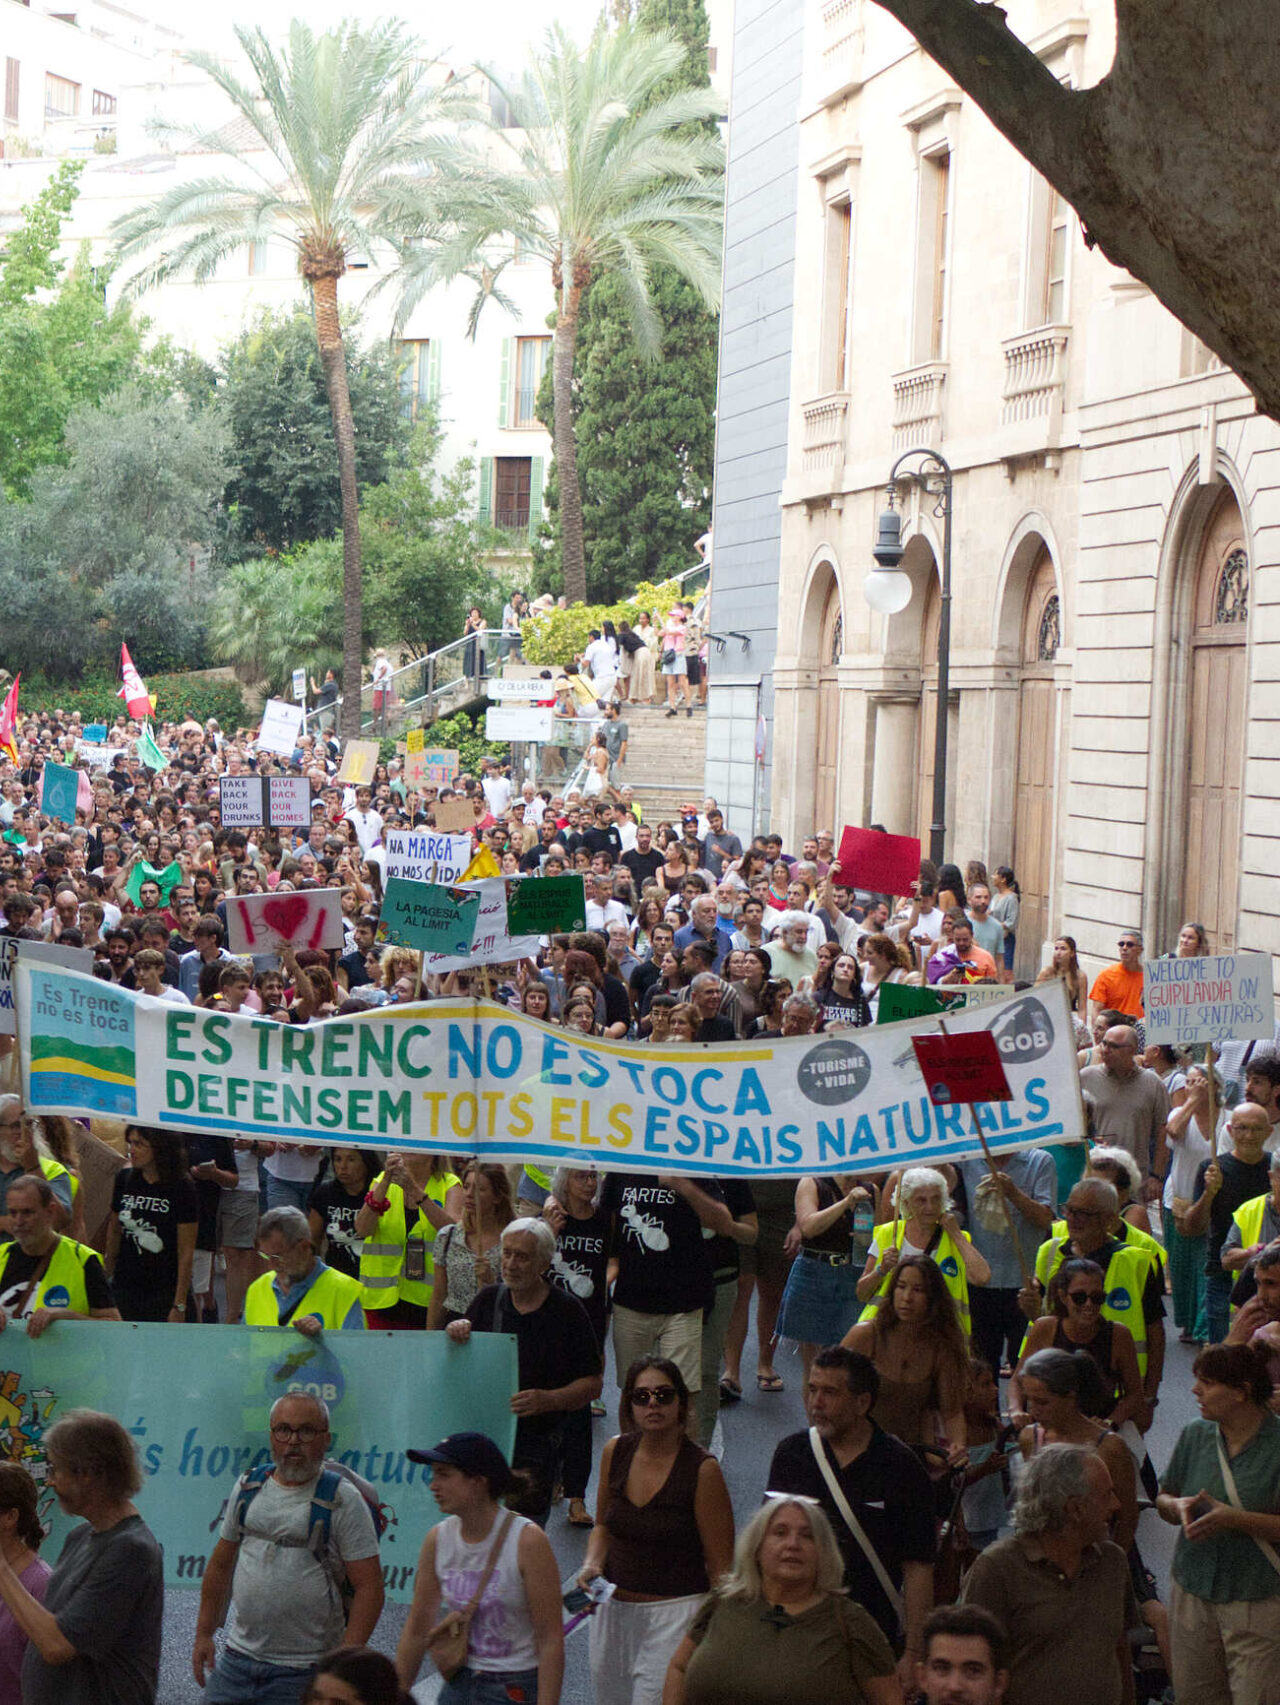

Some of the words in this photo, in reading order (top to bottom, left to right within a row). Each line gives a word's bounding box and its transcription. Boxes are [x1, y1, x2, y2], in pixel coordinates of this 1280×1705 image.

[223, 780, 247, 788] TAKE
[271, 780, 295, 788] GIVE
[223, 791, 248, 799] BACK
[271, 791, 297, 799] BACK
[271, 803, 291, 811] OUR
[223, 813, 260, 821] DRUNKS
[271, 814, 304, 822] HOMES
[389, 839, 404, 855] NA
[408, 837, 452, 861] MARGA
[387, 866, 400, 878] NO
[402, 866, 423, 880] MOS
[395, 901, 410, 914] LA
[404, 915, 419, 927] AL
[1147, 958, 1208, 984] WELCOME
[1214, 956, 1235, 979] TO
[1239, 976, 1259, 1001] ON
[43, 983, 63, 1003] Es
[70, 987, 120, 1014] Trenc
[36, 1000, 57, 1017] no
[63, 1008, 83, 1025] es
[88, 1009, 130, 1033] toca
[891, 1006, 906, 1017] EL
[1150, 1007, 1170, 1028] MAI
[1177, 1007, 1191, 1026] TE
[997, 1030, 1049, 1055] GOB
[1174, 1027, 1200, 1042] TOT
[1209, 1026, 1238, 1040] SOL
[166, 1009, 233, 1066] ES
[250, 1019, 432, 1079] TRENC
[448, 1023, 523, 1080] NO
[540, 1032, 610, 1089] ES
[617, 1059, 772, 1117] TOCA
[824, 1071, 857, 1089] VIDA
[166, 1068, 411, 1136] DEFENSEM
[423, 1090, 535, 1139] TOTS
[550, 1096, 634, 1149] ELS
[644, 1105, 803, 1166] ESPAIS
[816, 1076, 1051, 1163] NATURALS
[120, 1194, 170, 1213] FARTES
[622, 1187, 676, 1205] FARTES
[327, 1205, 360, 1222] FART
[556, 1235, 603, 1254] ARTES
